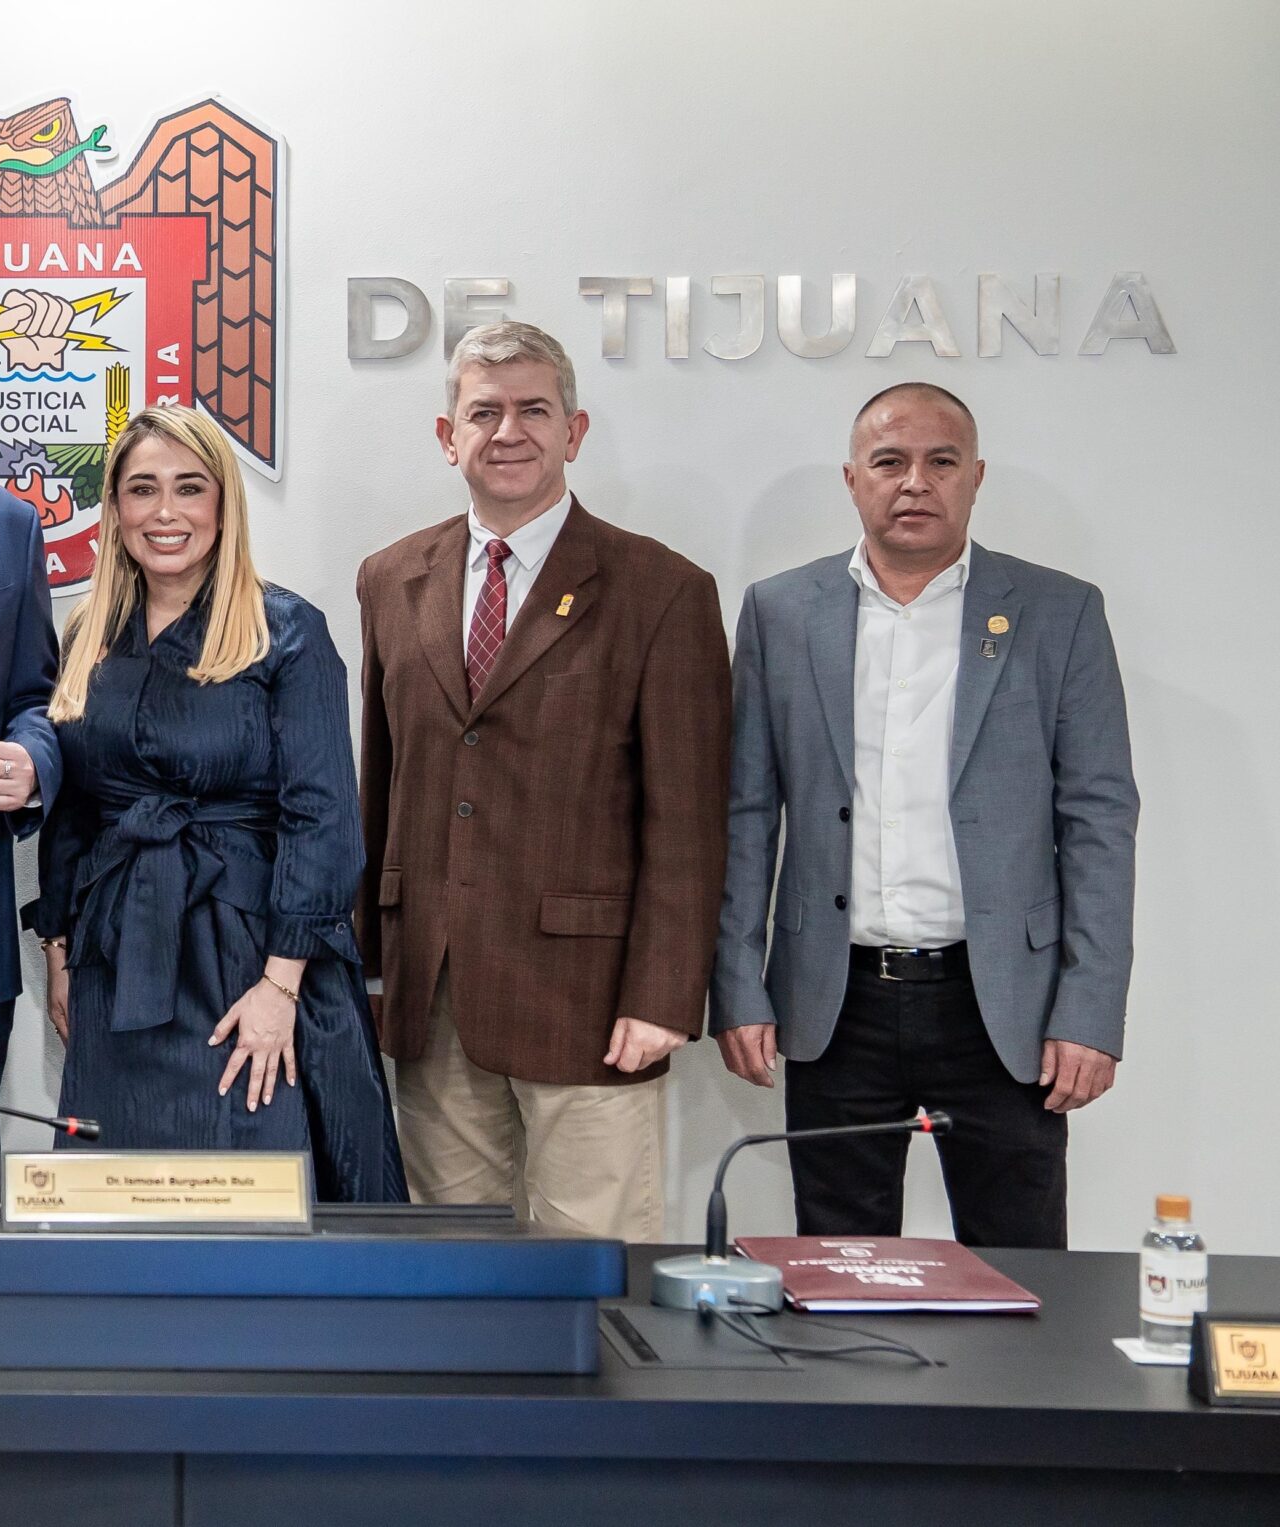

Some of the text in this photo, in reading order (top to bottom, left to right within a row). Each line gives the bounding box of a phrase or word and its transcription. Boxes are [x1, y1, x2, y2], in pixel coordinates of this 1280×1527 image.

[347, 277, 509, 360] DE
[578, 271, 1177, 359] TIJUANA
[157, 343, 179, 407] RIA
[17, 1196, 65, 1206] TIJUANA
[1224, 1368, 1279, 1380] TIJUANA
